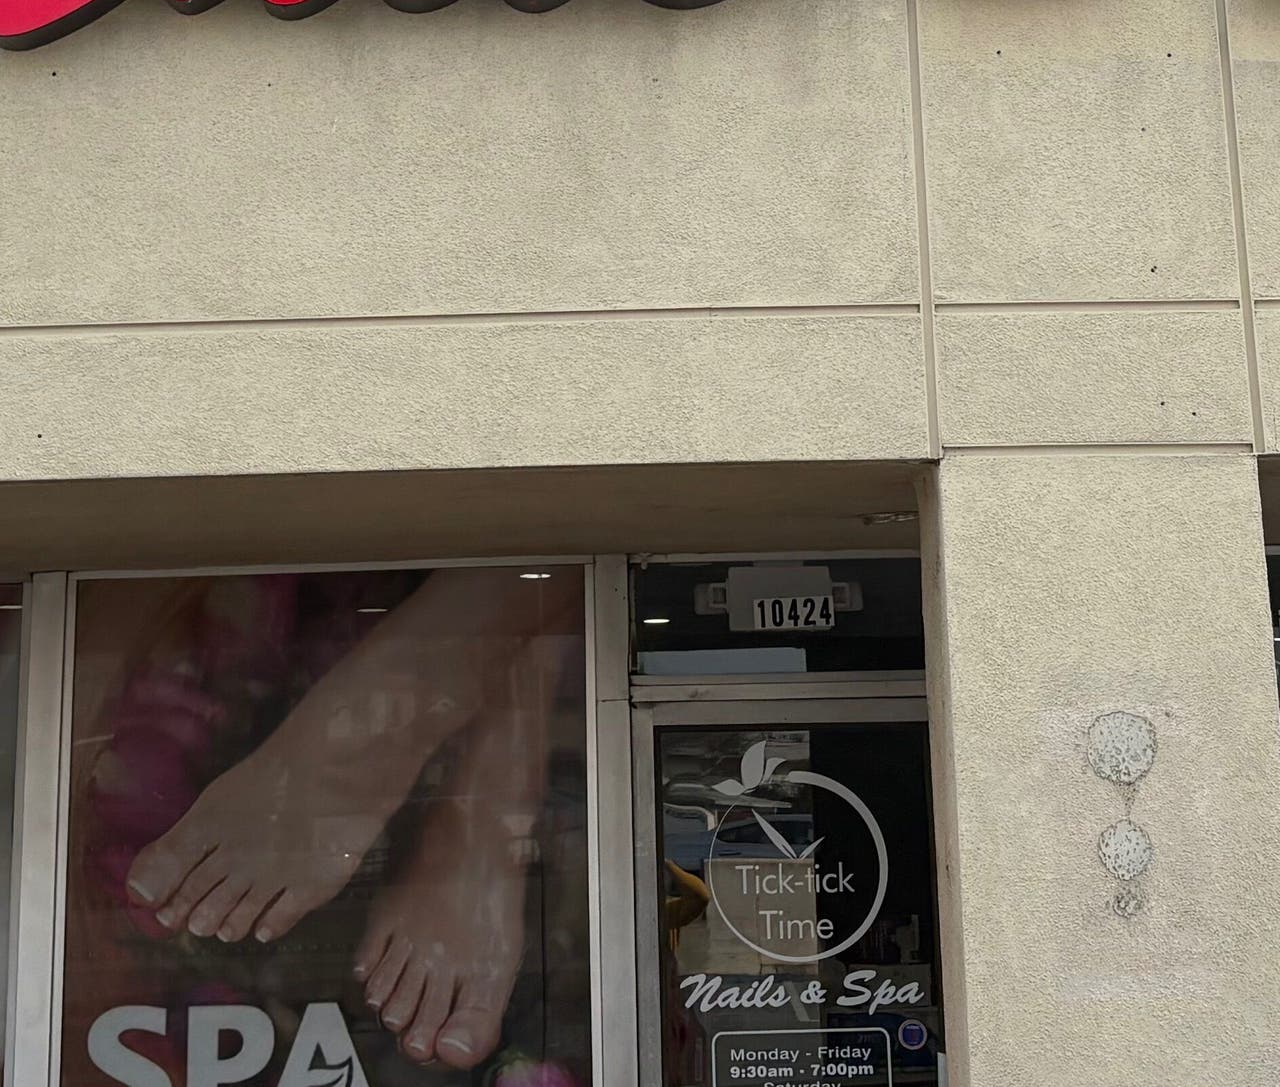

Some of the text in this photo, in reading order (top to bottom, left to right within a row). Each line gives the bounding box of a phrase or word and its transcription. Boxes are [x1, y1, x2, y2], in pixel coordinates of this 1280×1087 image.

[757, 597, 832, 628] 10424
[734, 862, 855, 895] Tick-tick
[758, 910, 834, 941] Time
[680, 969, 925, 1015] Nails & Spa
[87, 1001, 371, 1087] SPA
[730, 1048, 800, 1063] Monday
[818, 1045, 872, 1061] Friday
[730, 1065, 794, 1079] 9:30am
[810, 1063, 874, 1078] 7:00pm
